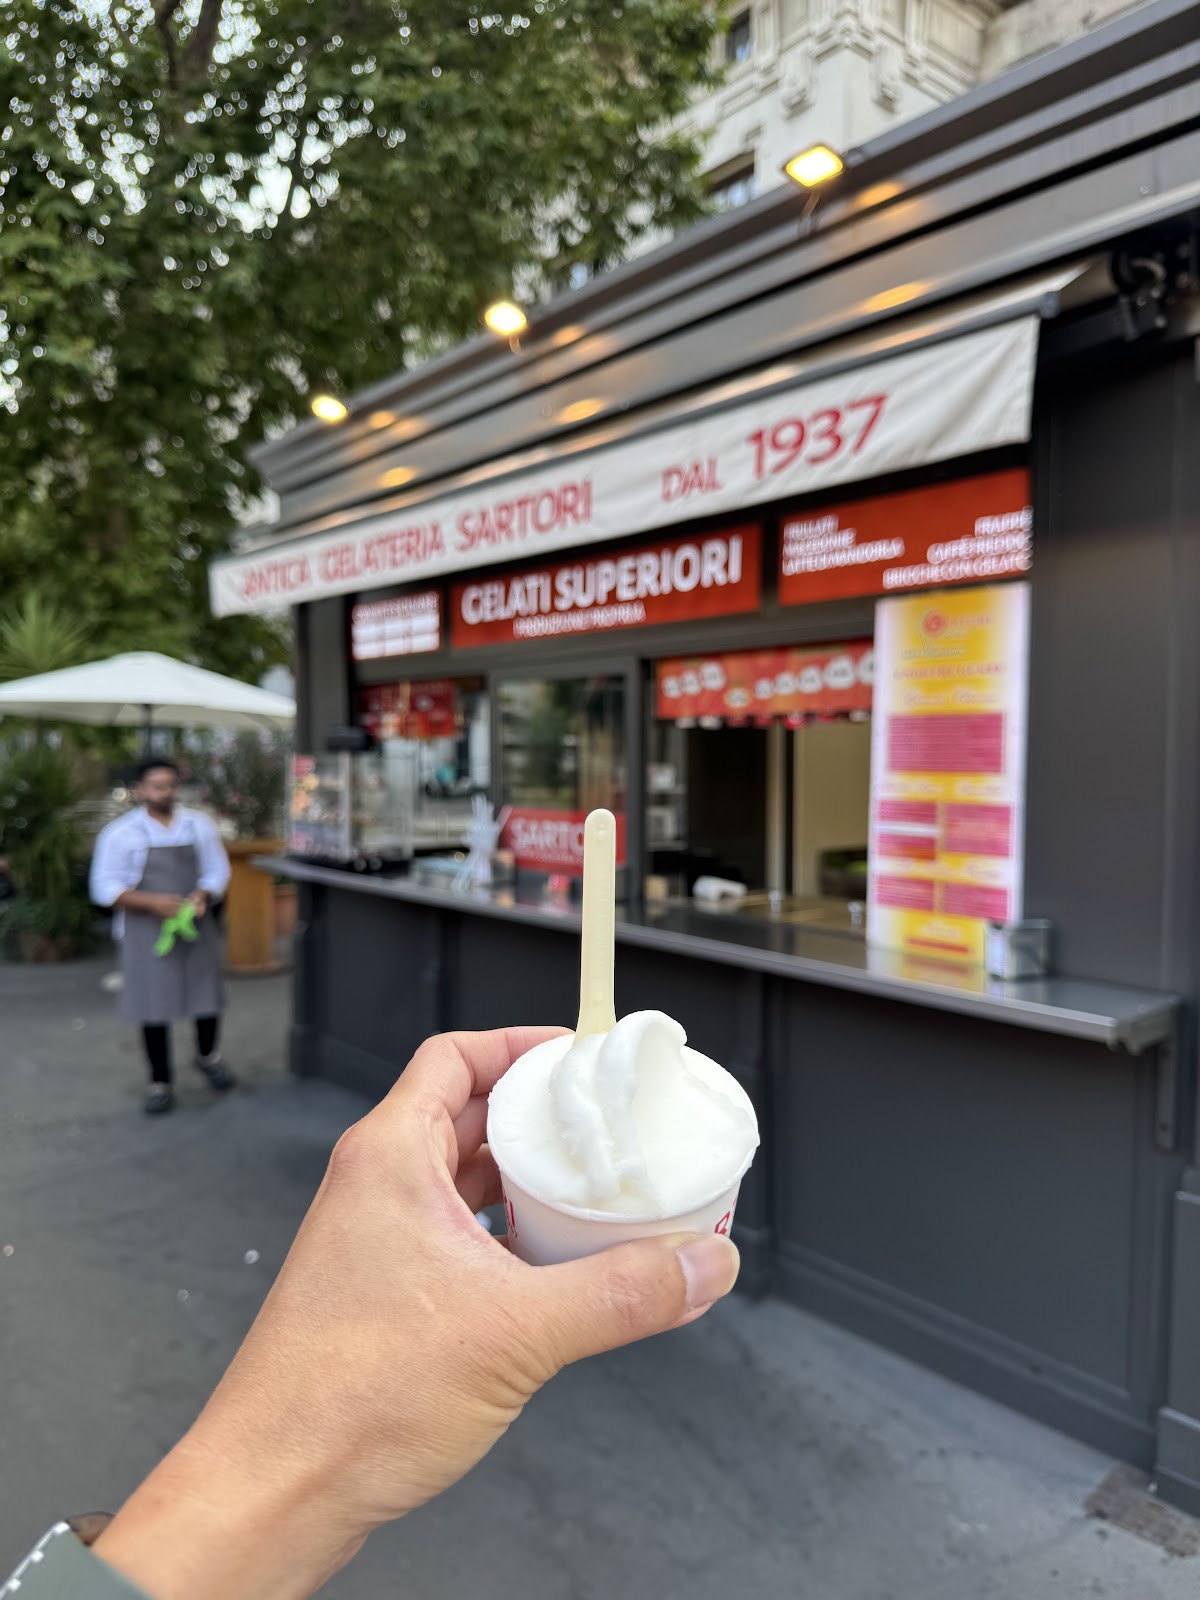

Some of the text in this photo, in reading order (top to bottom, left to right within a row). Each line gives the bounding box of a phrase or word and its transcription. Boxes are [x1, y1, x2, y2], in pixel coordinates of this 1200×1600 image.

[242, 393, 889, 598] ANTICA GELATERIA SARTORI DAL 1937
[461, 572, 551, 624] GELATI
[554, 535, 743, 610] SUPERIORI
[511, 818, 584, 857] SARTO
